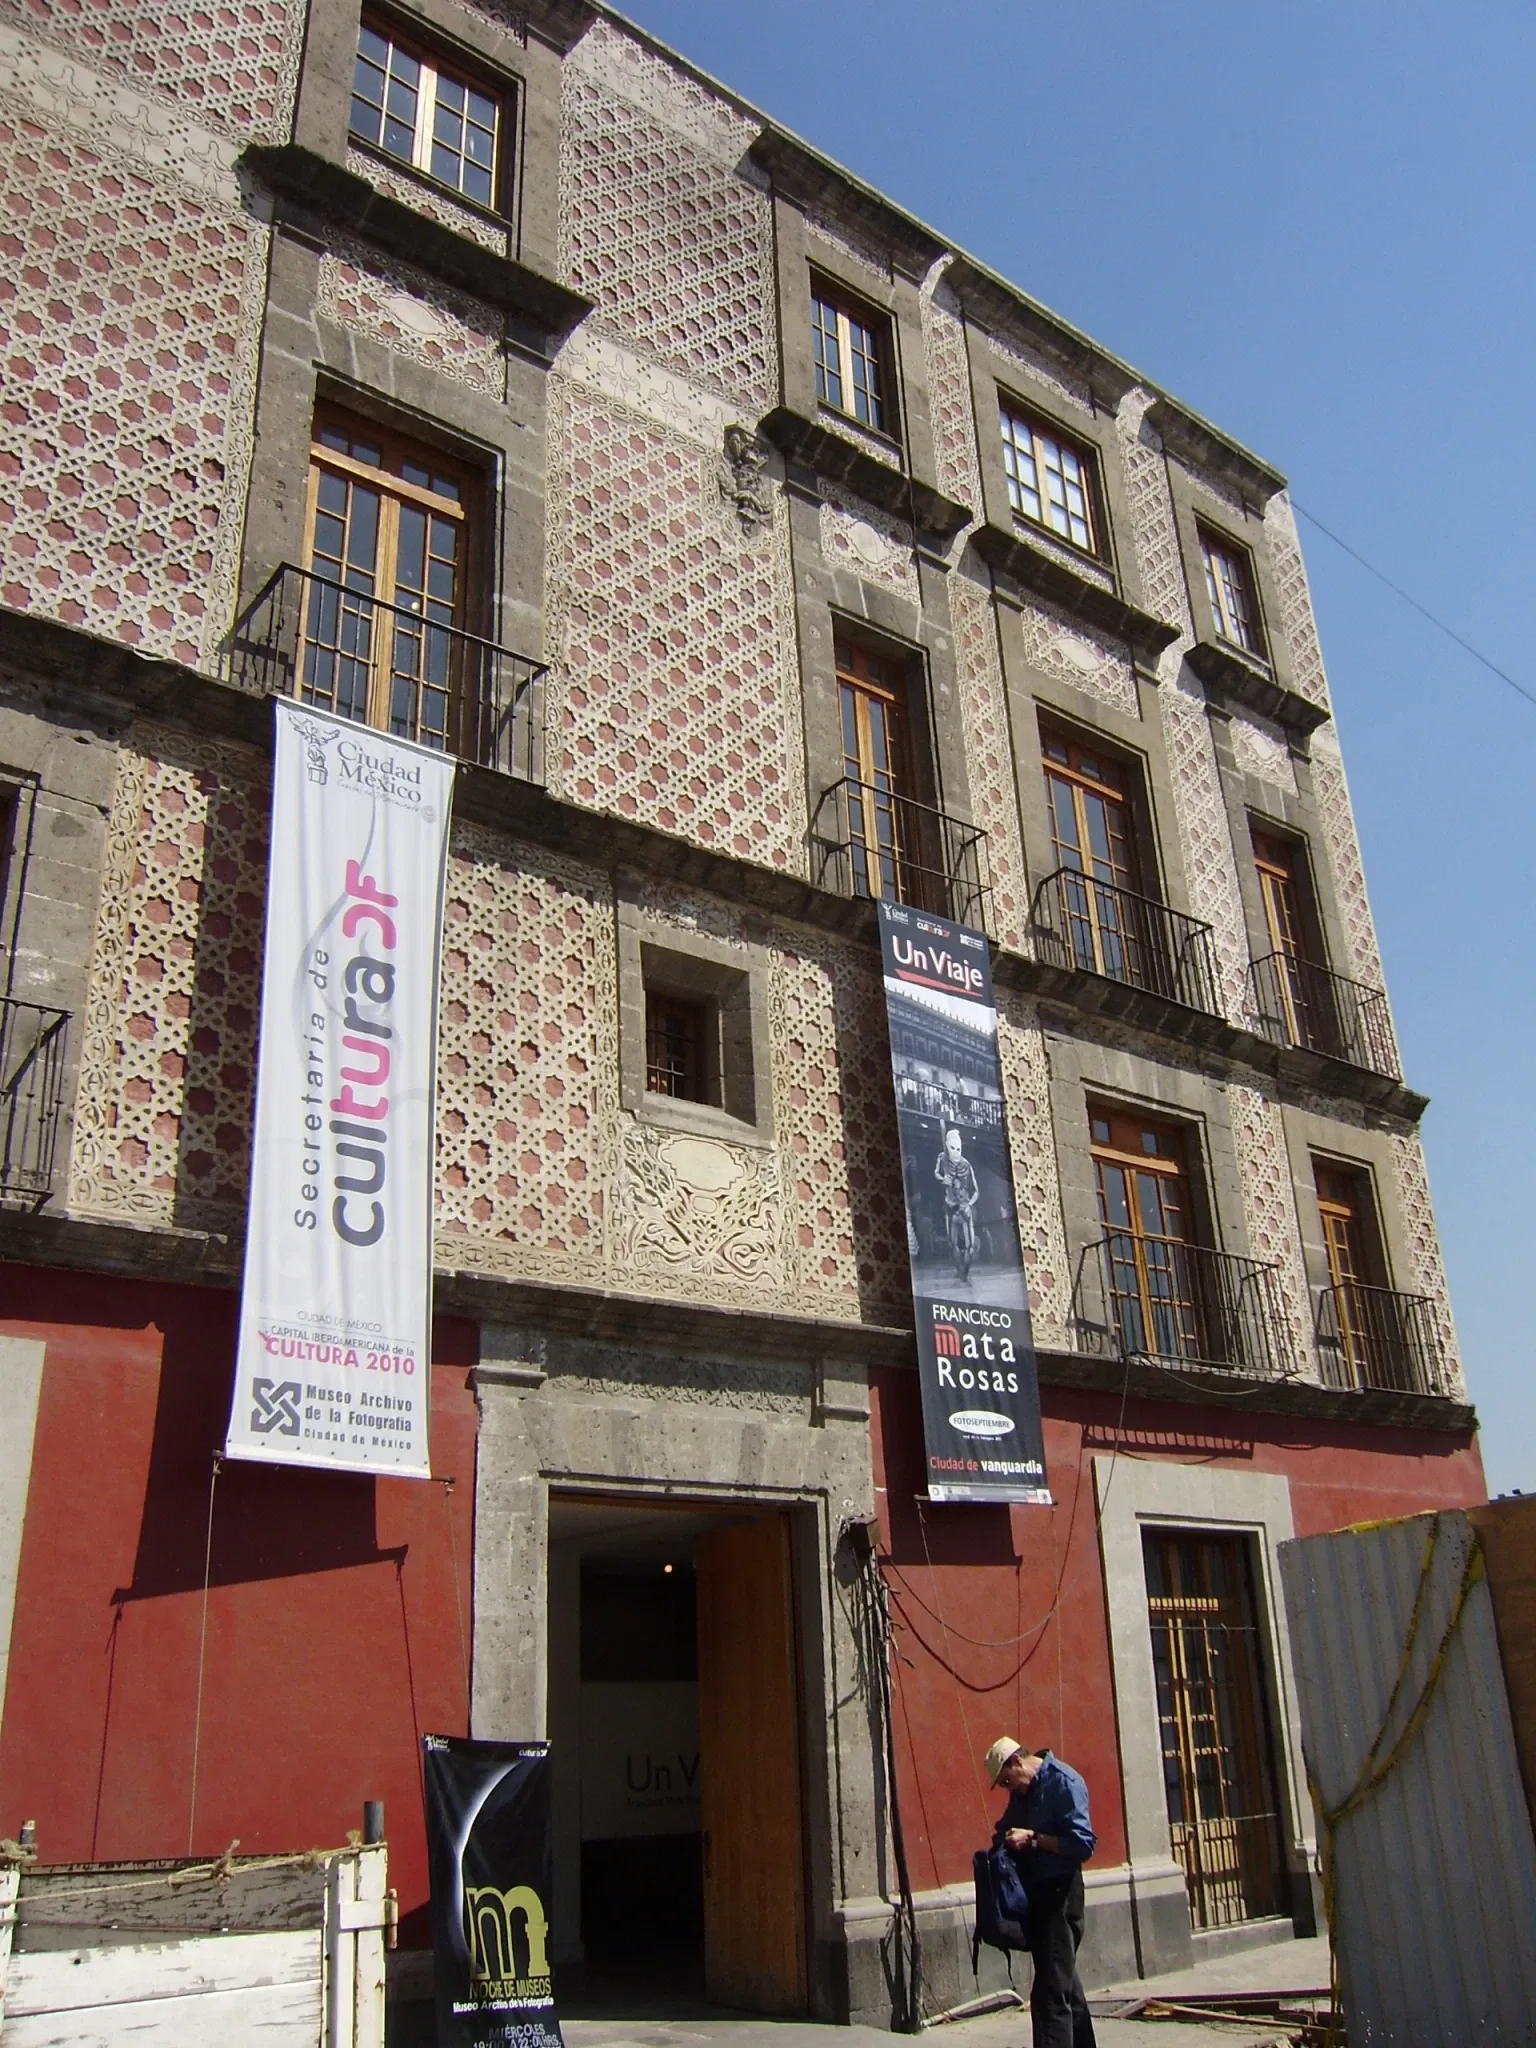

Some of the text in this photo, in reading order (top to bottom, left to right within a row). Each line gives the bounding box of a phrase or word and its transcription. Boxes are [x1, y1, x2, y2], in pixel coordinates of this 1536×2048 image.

[337, 740, 422, 785] Ciudad
[338, 757, 422, 804] México
[308, 949, 329, 990] de
[892, 935, 984, 991] Un Viaje
[297, 1310, 332, 1325] CIUDAD
[932, 1304, 1012, 1329] FRANCISCO
[271, 1325, 415, 1357] CAPITAL IBEROAMERICANA de la
[262, 1335, 415, 1376] CULTURA 2010
[937, 1356, 1019, 1394] Rosas
[306, 1384, 413, 1412] Museo Archivo
[305, 1404, 321, 1421] de
[329, 1408, 342, 1423] la
[953, 1416, 1010, 1429] FOTOSEPTIEMBRE
[304, 1428, 346, 1443] Ciudad
[352, 1434, 365, 1445] de
[930, 1456, 1043, 1475] Ciudad de vanguardia
[626, 1755, 671, 1792] Un
[469, 1976, 552, 2000] NOCHE DE MUSEOS
[452, 2001, 479, 2013] Museo
